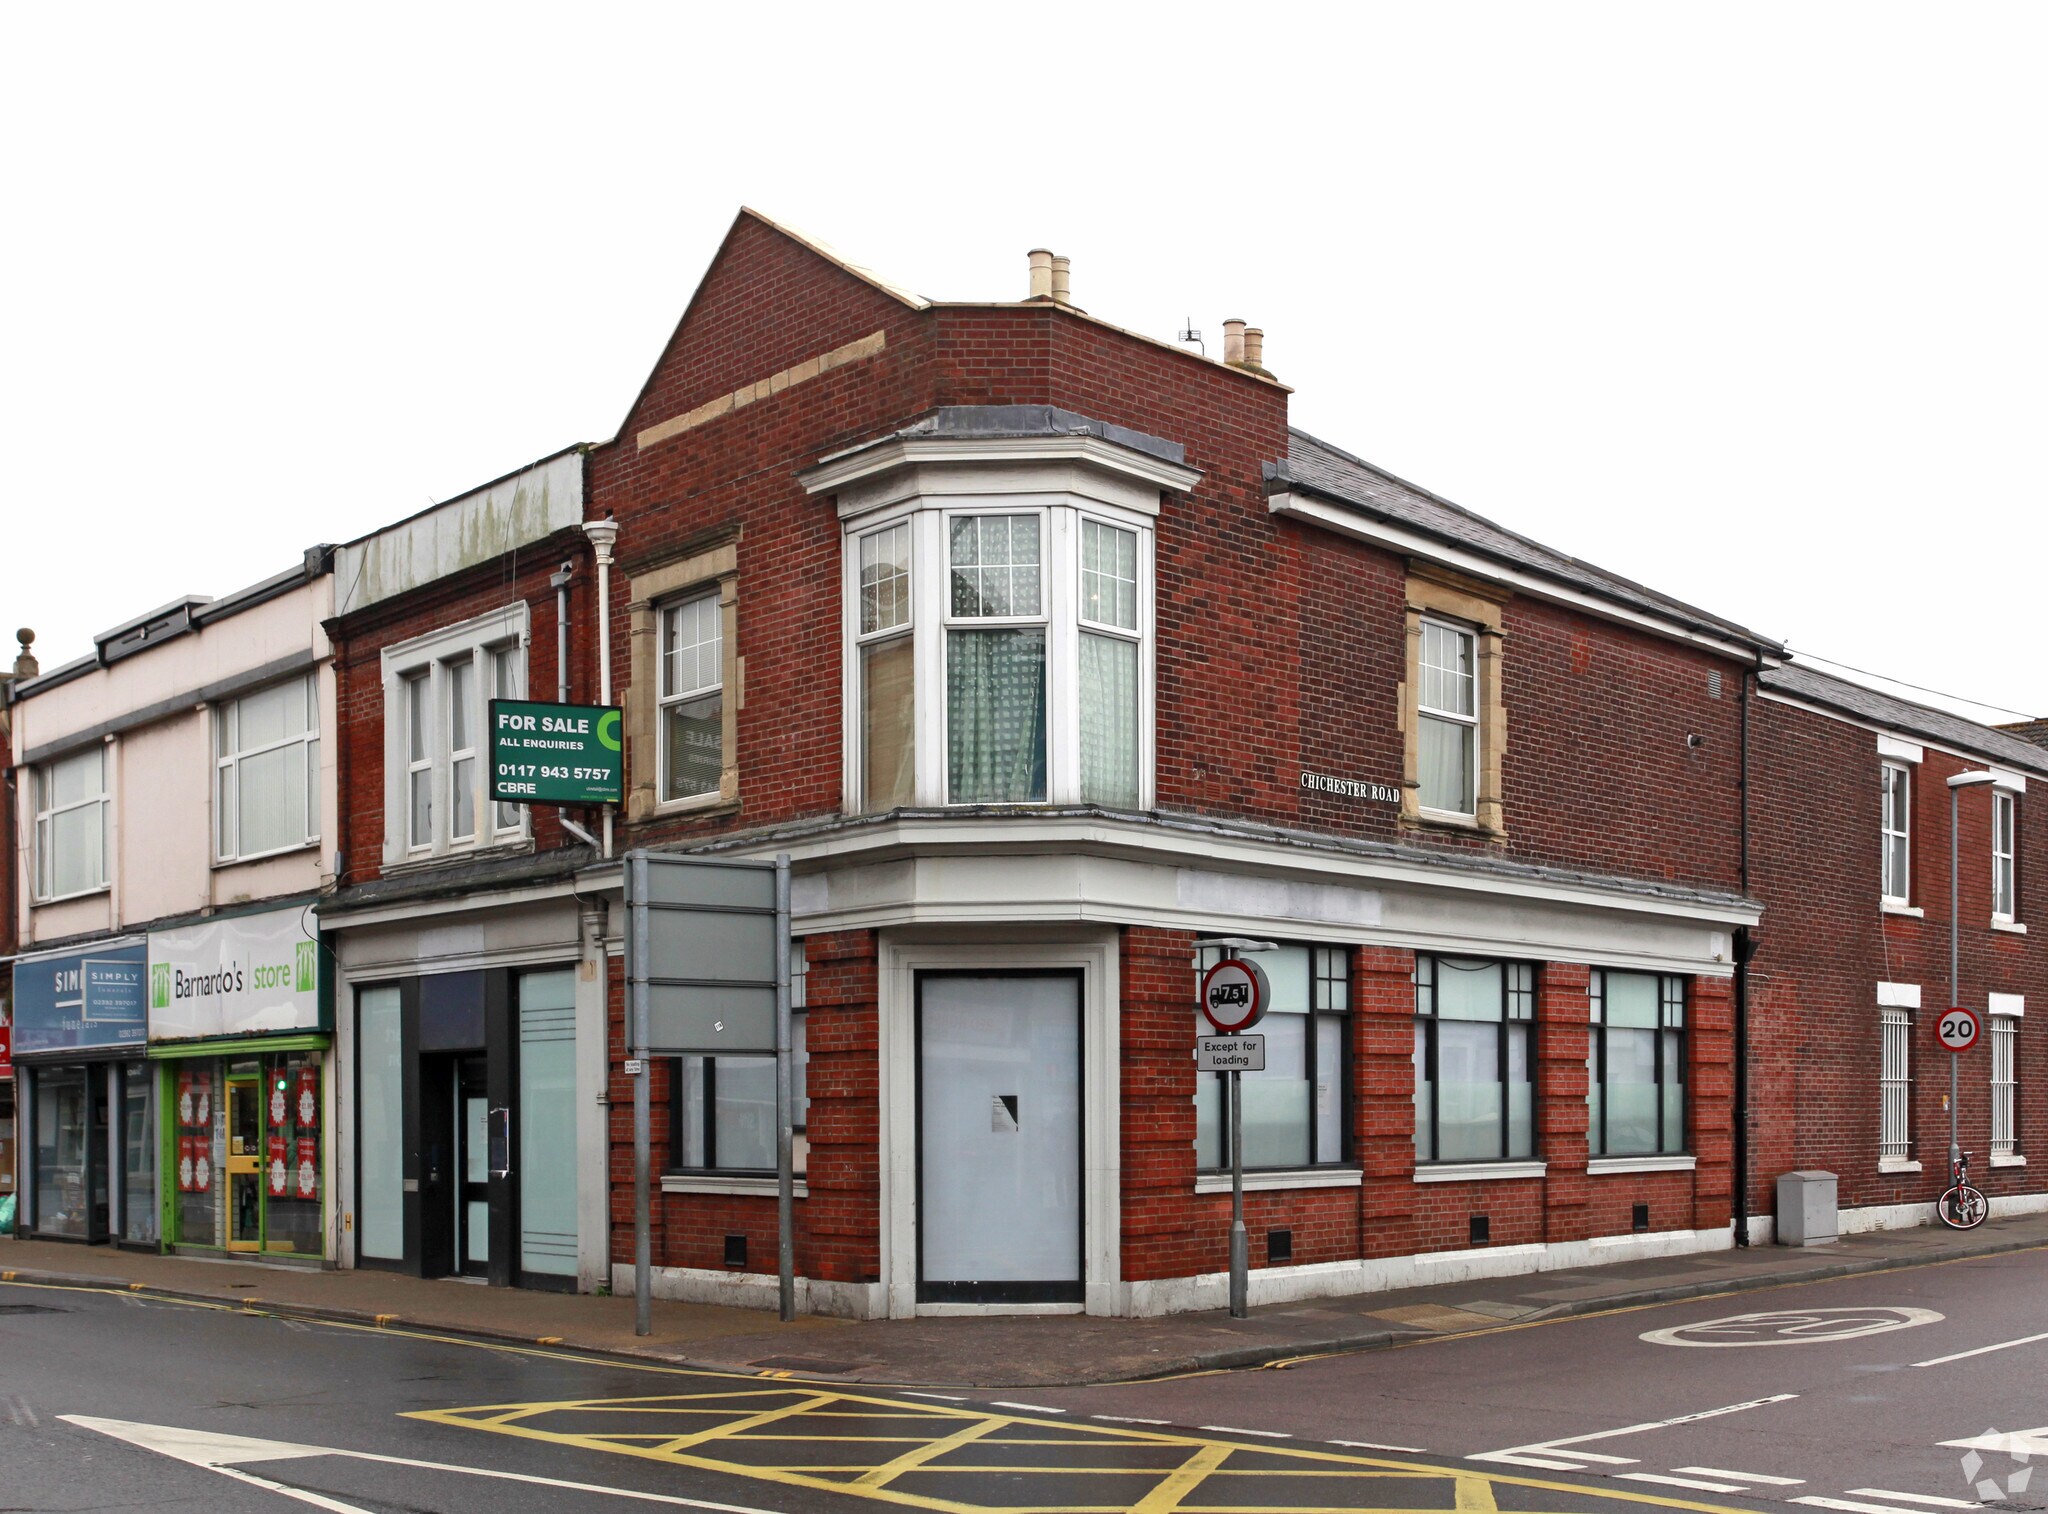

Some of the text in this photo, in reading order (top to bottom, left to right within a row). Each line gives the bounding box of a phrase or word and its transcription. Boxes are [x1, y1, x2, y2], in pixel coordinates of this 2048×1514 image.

[498, 714, 589, 734] FOR SALE
[499, 738, 584, 751] ALL ENQUIRIES
[498, 763, 611, 780] 0117 943 5757
[497, 782, 536, 794] CBRE
[1301, 772, 1400, 803] CHICHESTER ROAD
[55, 969, 83, 993] SIM
[91, 972, 138, 981] SIMPLY
[175, 961, 291, 999] Barnardo's store
[1942, 1020, 1973, 1038] 20
[1204, 1041, 1257, 1053] Except for
[1212, 1056, 1249, 1066] loading
[1685, 1316, 1901, 1336] 20
